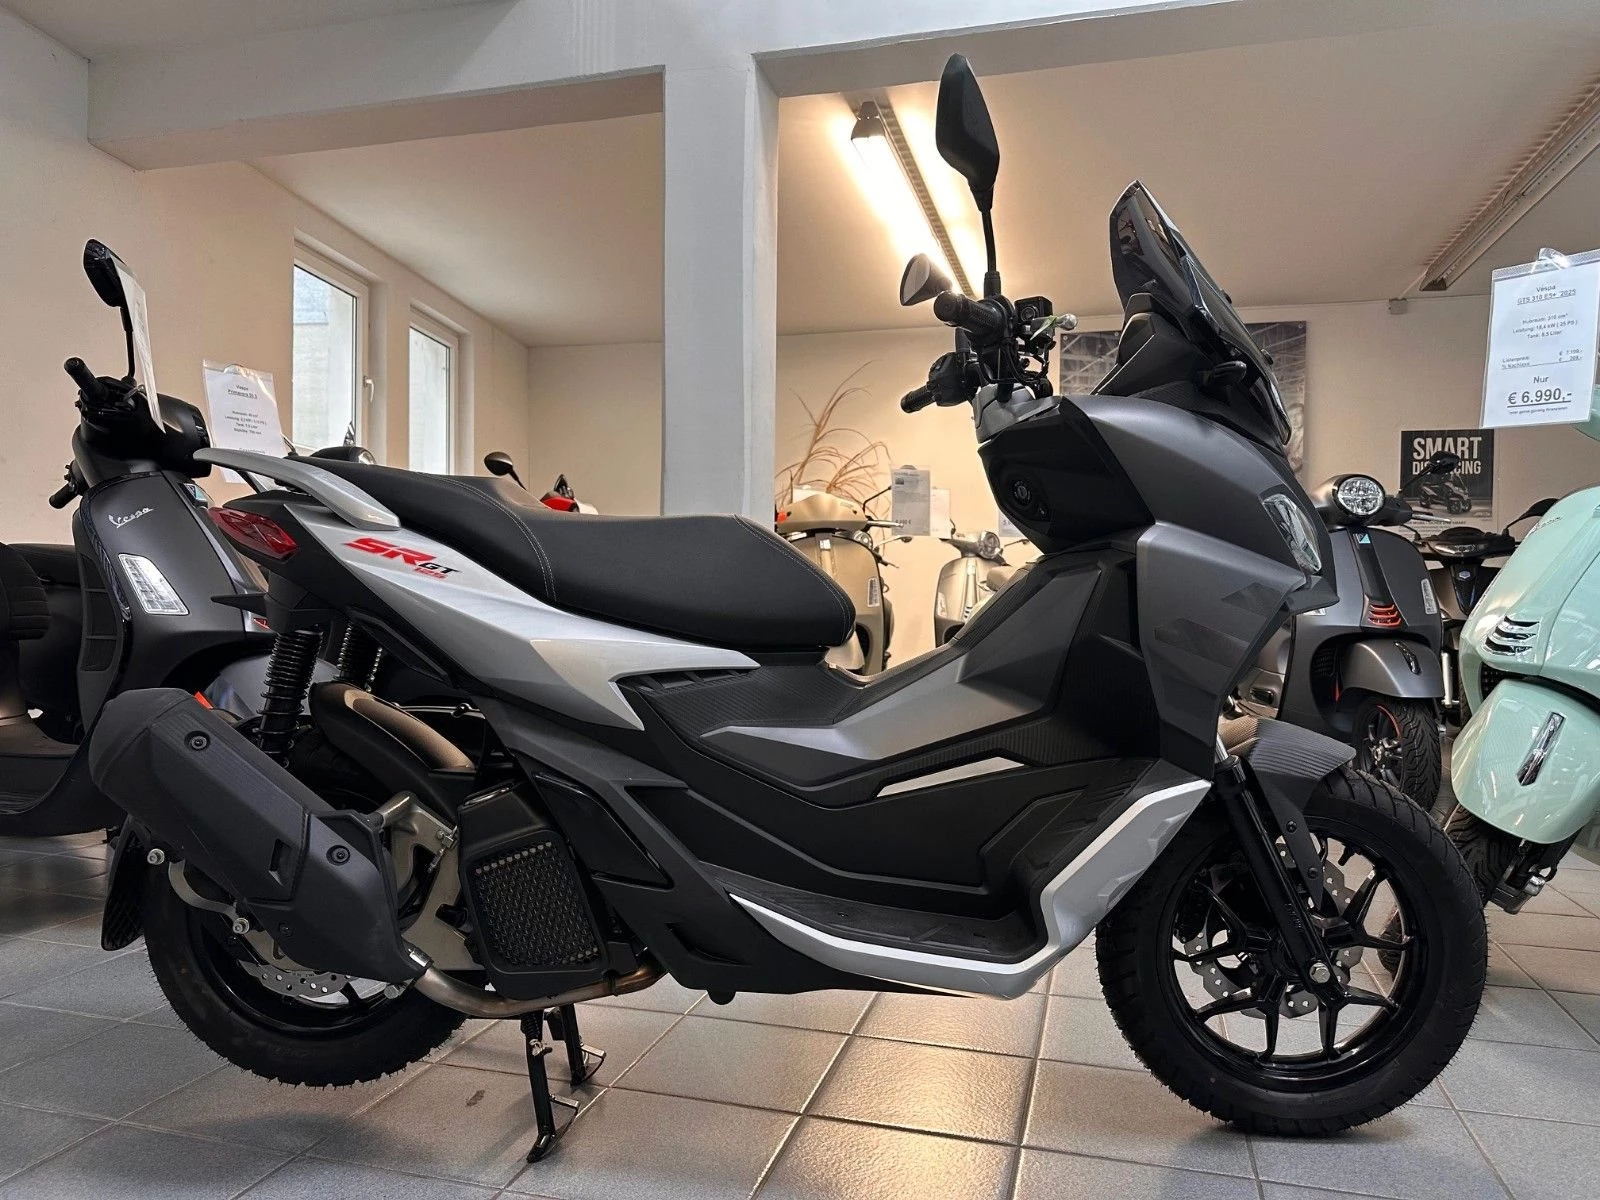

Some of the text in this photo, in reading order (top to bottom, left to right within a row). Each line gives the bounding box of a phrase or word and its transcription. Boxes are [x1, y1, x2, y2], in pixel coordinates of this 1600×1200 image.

[1536, 285, 1556, 293] Vespa
[1532, 294, 1543, 302] 310
[1533, 375, 1549, 384] Nur
[1508, 388, 1572, 405] € 6.990,-
[1413, 437, 1482, 460] SMART
[108, 507, 154, 529] Vespa
[343, 538, 437, 565] SR
[418, 562, 462, 574] GT
